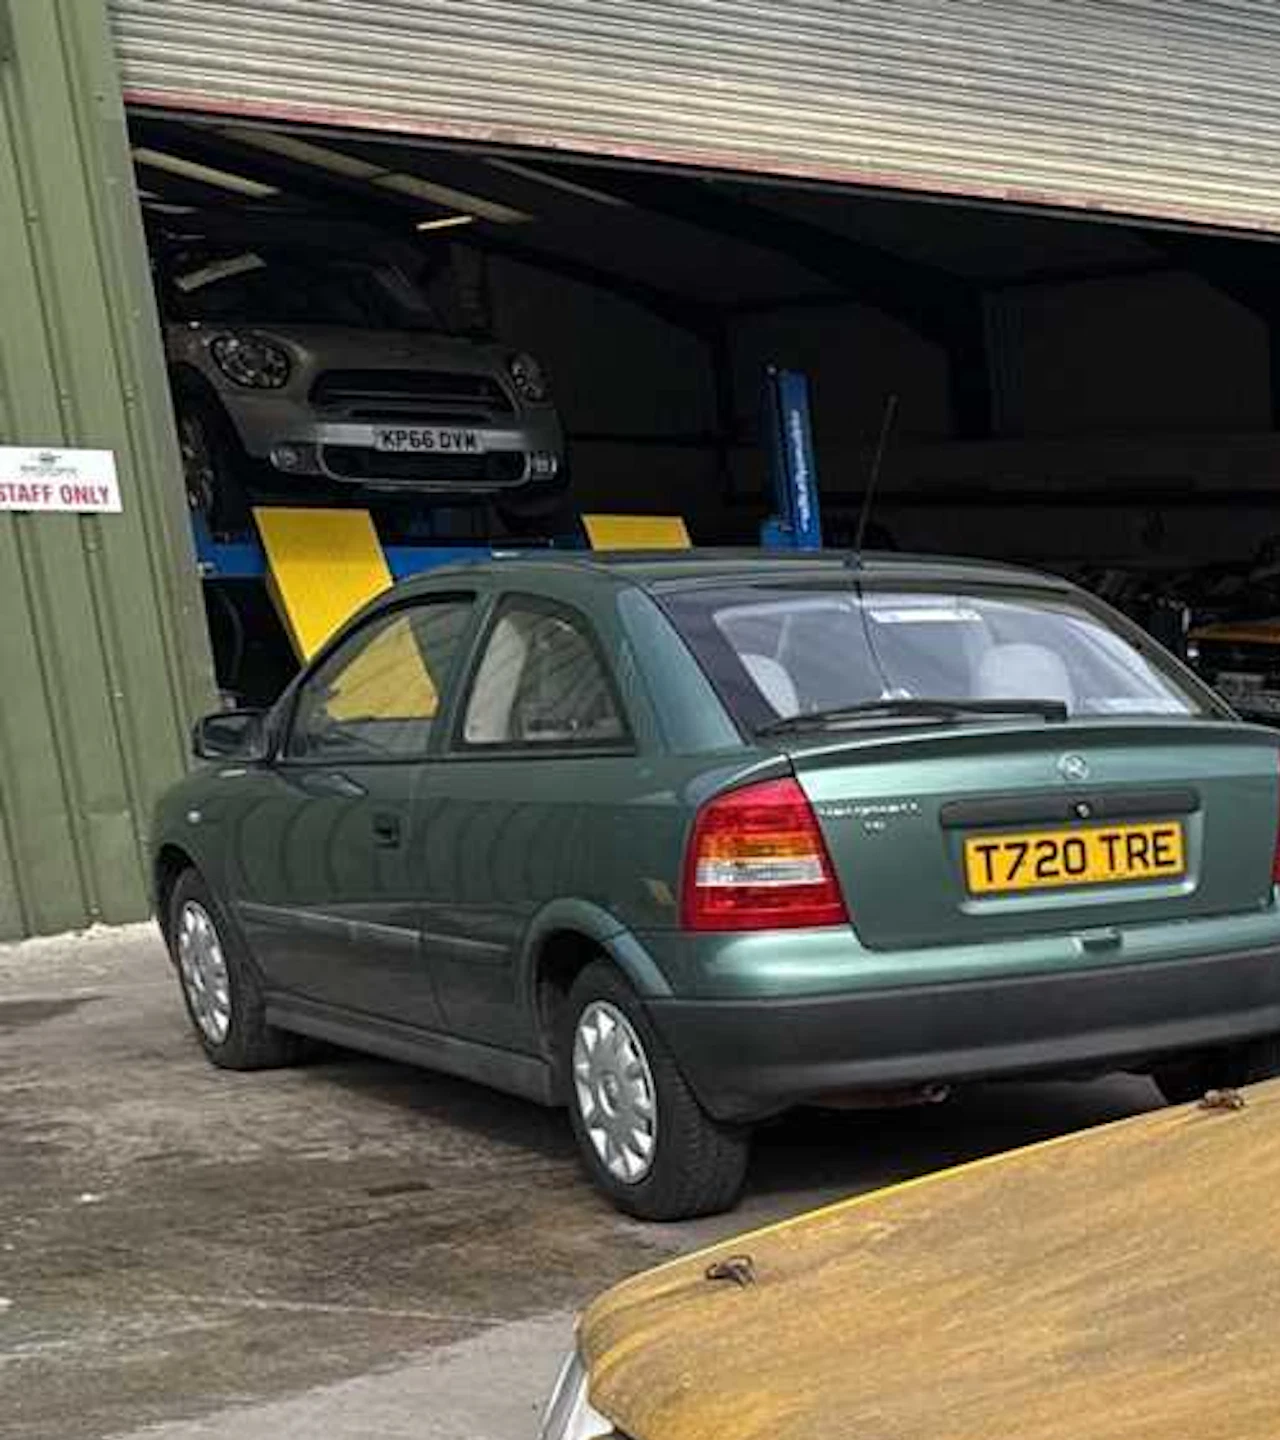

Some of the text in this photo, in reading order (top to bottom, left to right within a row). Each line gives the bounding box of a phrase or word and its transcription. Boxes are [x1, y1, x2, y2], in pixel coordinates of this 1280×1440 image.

[60, 484, 110, 505] ONLY
[974, 829, 1176, 883] T720 TRE
